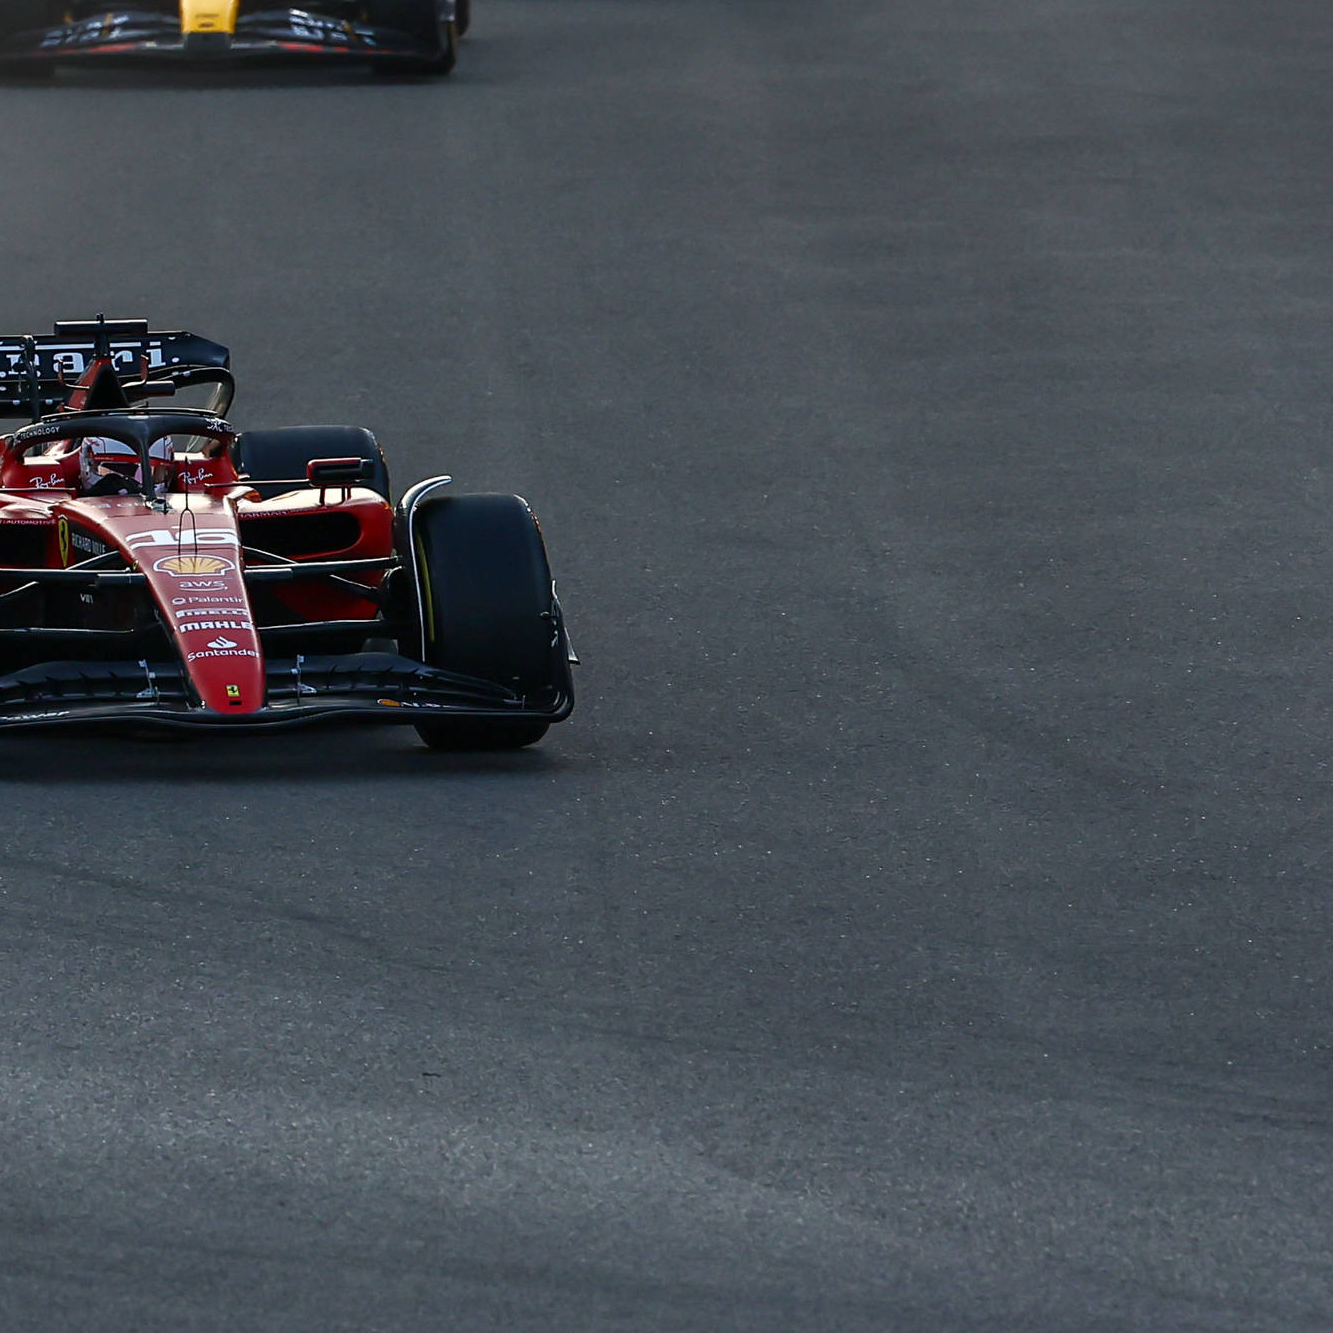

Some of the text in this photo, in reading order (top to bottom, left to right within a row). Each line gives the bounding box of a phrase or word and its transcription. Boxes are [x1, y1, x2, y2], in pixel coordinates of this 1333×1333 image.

[124, 526, 241, 550] 16
[179, 580, 226, 588] aws
[188, 596, 244, 604] Palantir
[178, 621, 254, 634] MAHLE
[187, 649, 261, 663] Santander
